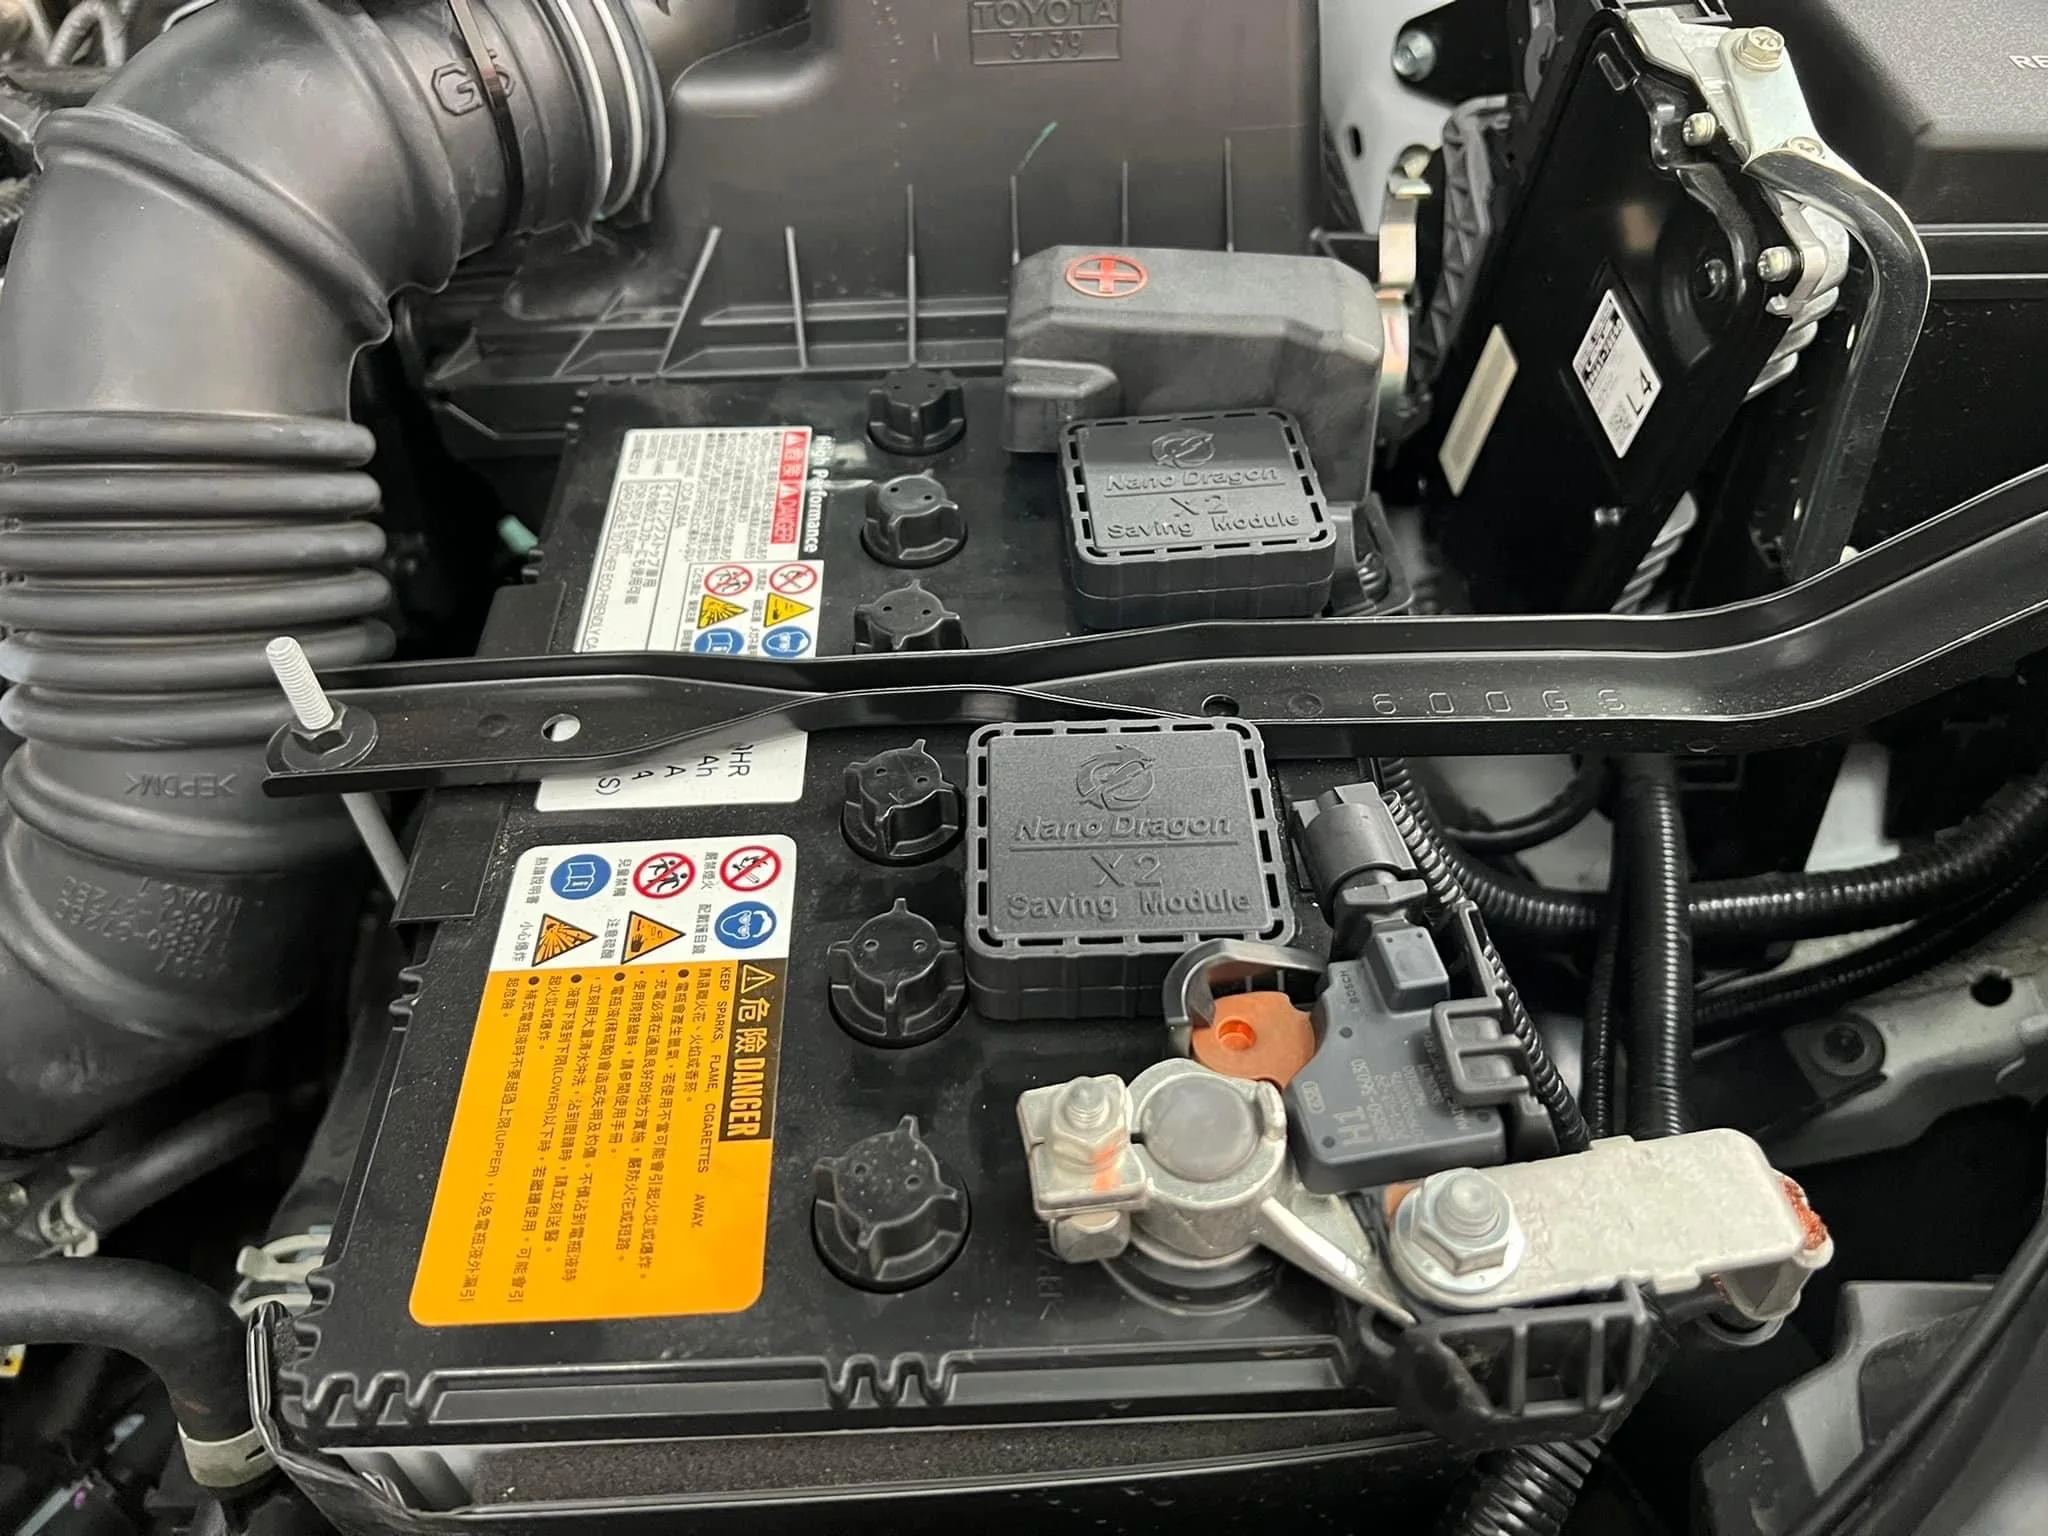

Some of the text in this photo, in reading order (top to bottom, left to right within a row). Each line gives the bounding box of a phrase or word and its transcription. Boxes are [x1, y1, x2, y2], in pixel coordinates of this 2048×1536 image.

[973, 0, 1119, 30] TOYOTA
[1106, 467, 1278, 492] Nano Dragon
[803, 469, 829, 553] Performance
[1107, 511, 1300, 540] Saving Module
[1015, 813, 1231, 841] Nano Dragon
[1007, 888, 1251, 923] Saving Module
[719, 966, 733, 992] KEEP
[726, 1056, 766, 1138] DANGER
[697, 1103, 717, 1174] CIGARETTES
